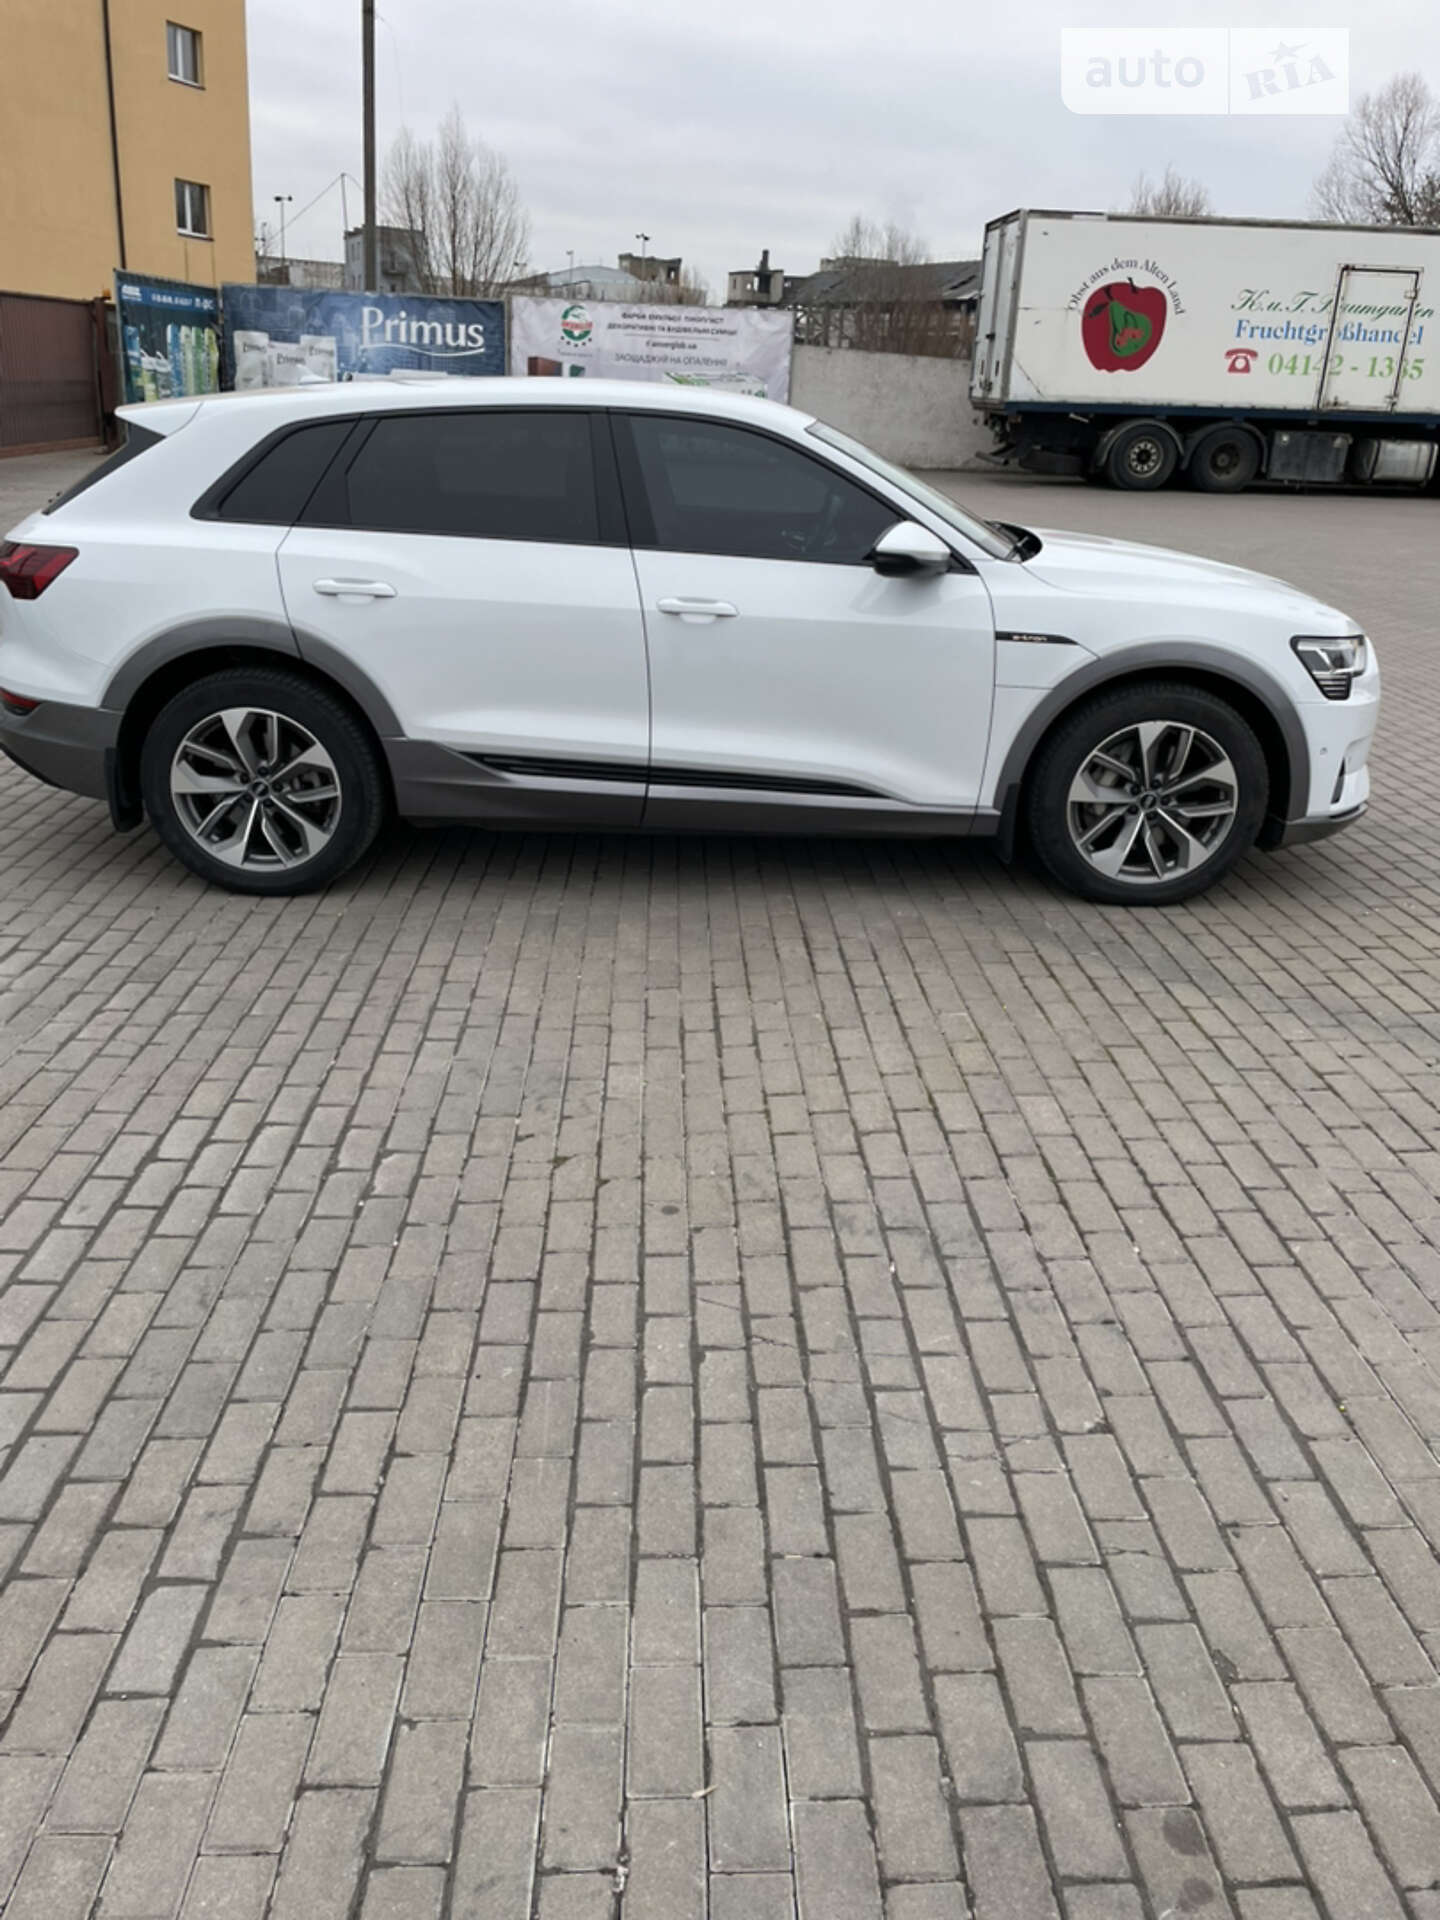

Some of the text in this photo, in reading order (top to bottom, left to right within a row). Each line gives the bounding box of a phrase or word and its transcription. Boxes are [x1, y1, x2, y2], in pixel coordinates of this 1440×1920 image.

[1089, 266, 1109, 283] aus
[1110, 257, 1138, 271] dem
[1139, 258, 1169, 284] Alten
[1167, 280, 1187, 316] Land
[361, 306, 485, 348] Primus
[1235, 318, 1424, 345] Fruchtgrßhanel
